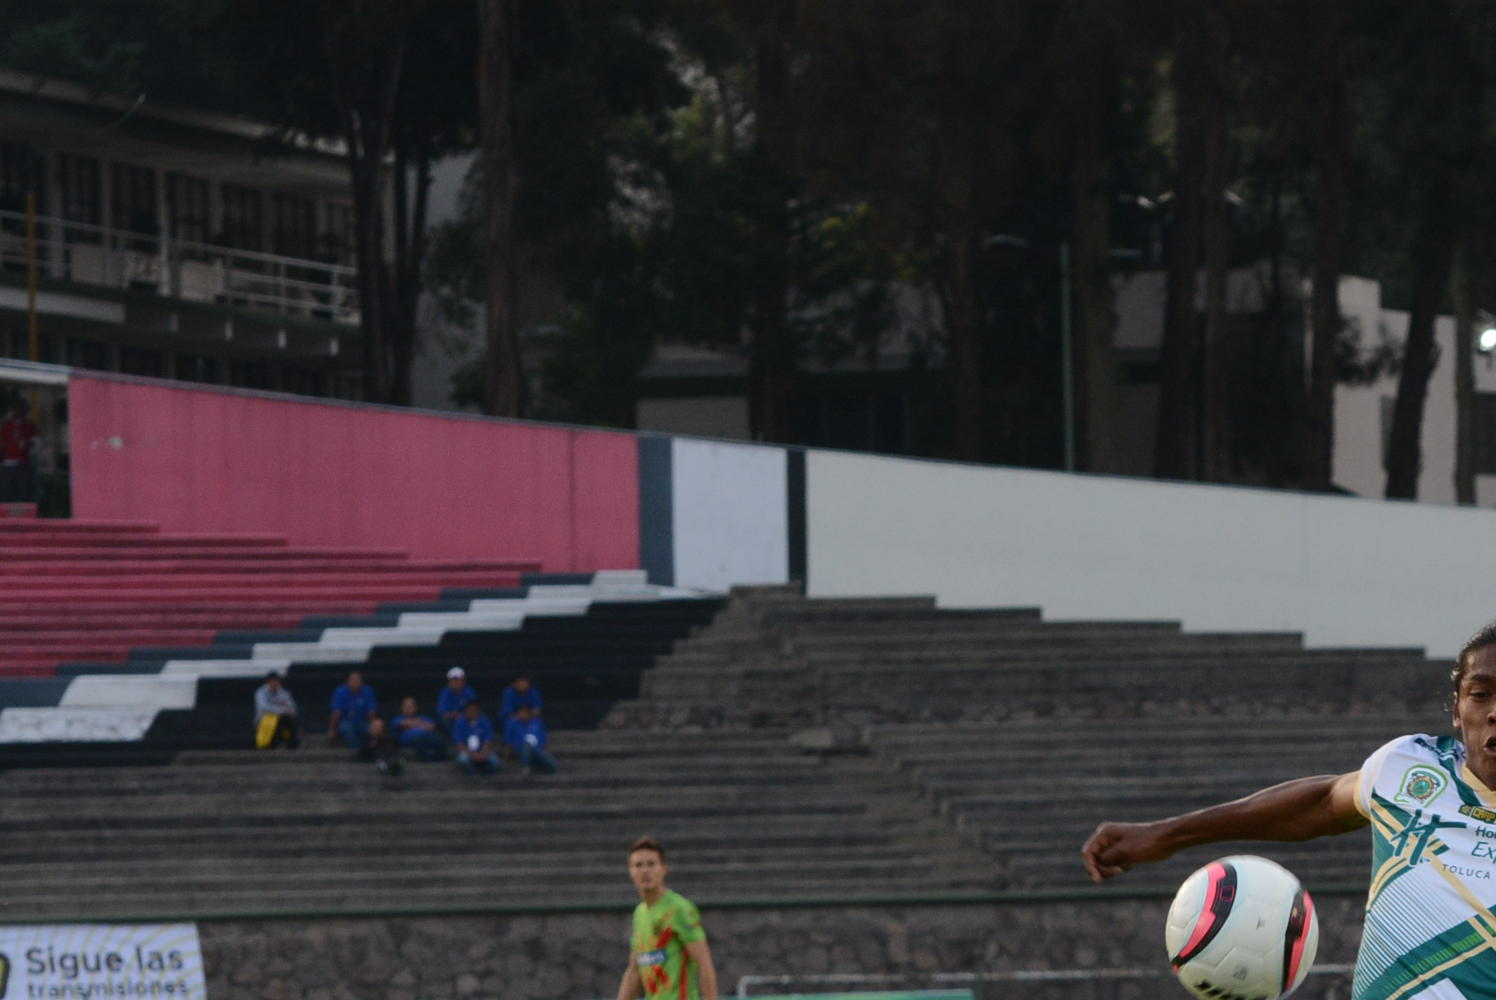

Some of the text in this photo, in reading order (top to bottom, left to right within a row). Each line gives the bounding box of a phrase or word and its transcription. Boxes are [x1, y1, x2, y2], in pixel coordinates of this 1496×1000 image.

[1442, 864, 1491, 881] TOLUCA
[25, 945, 184, 980] Sigue las
[28, 979, 188, 999] transmisiones
